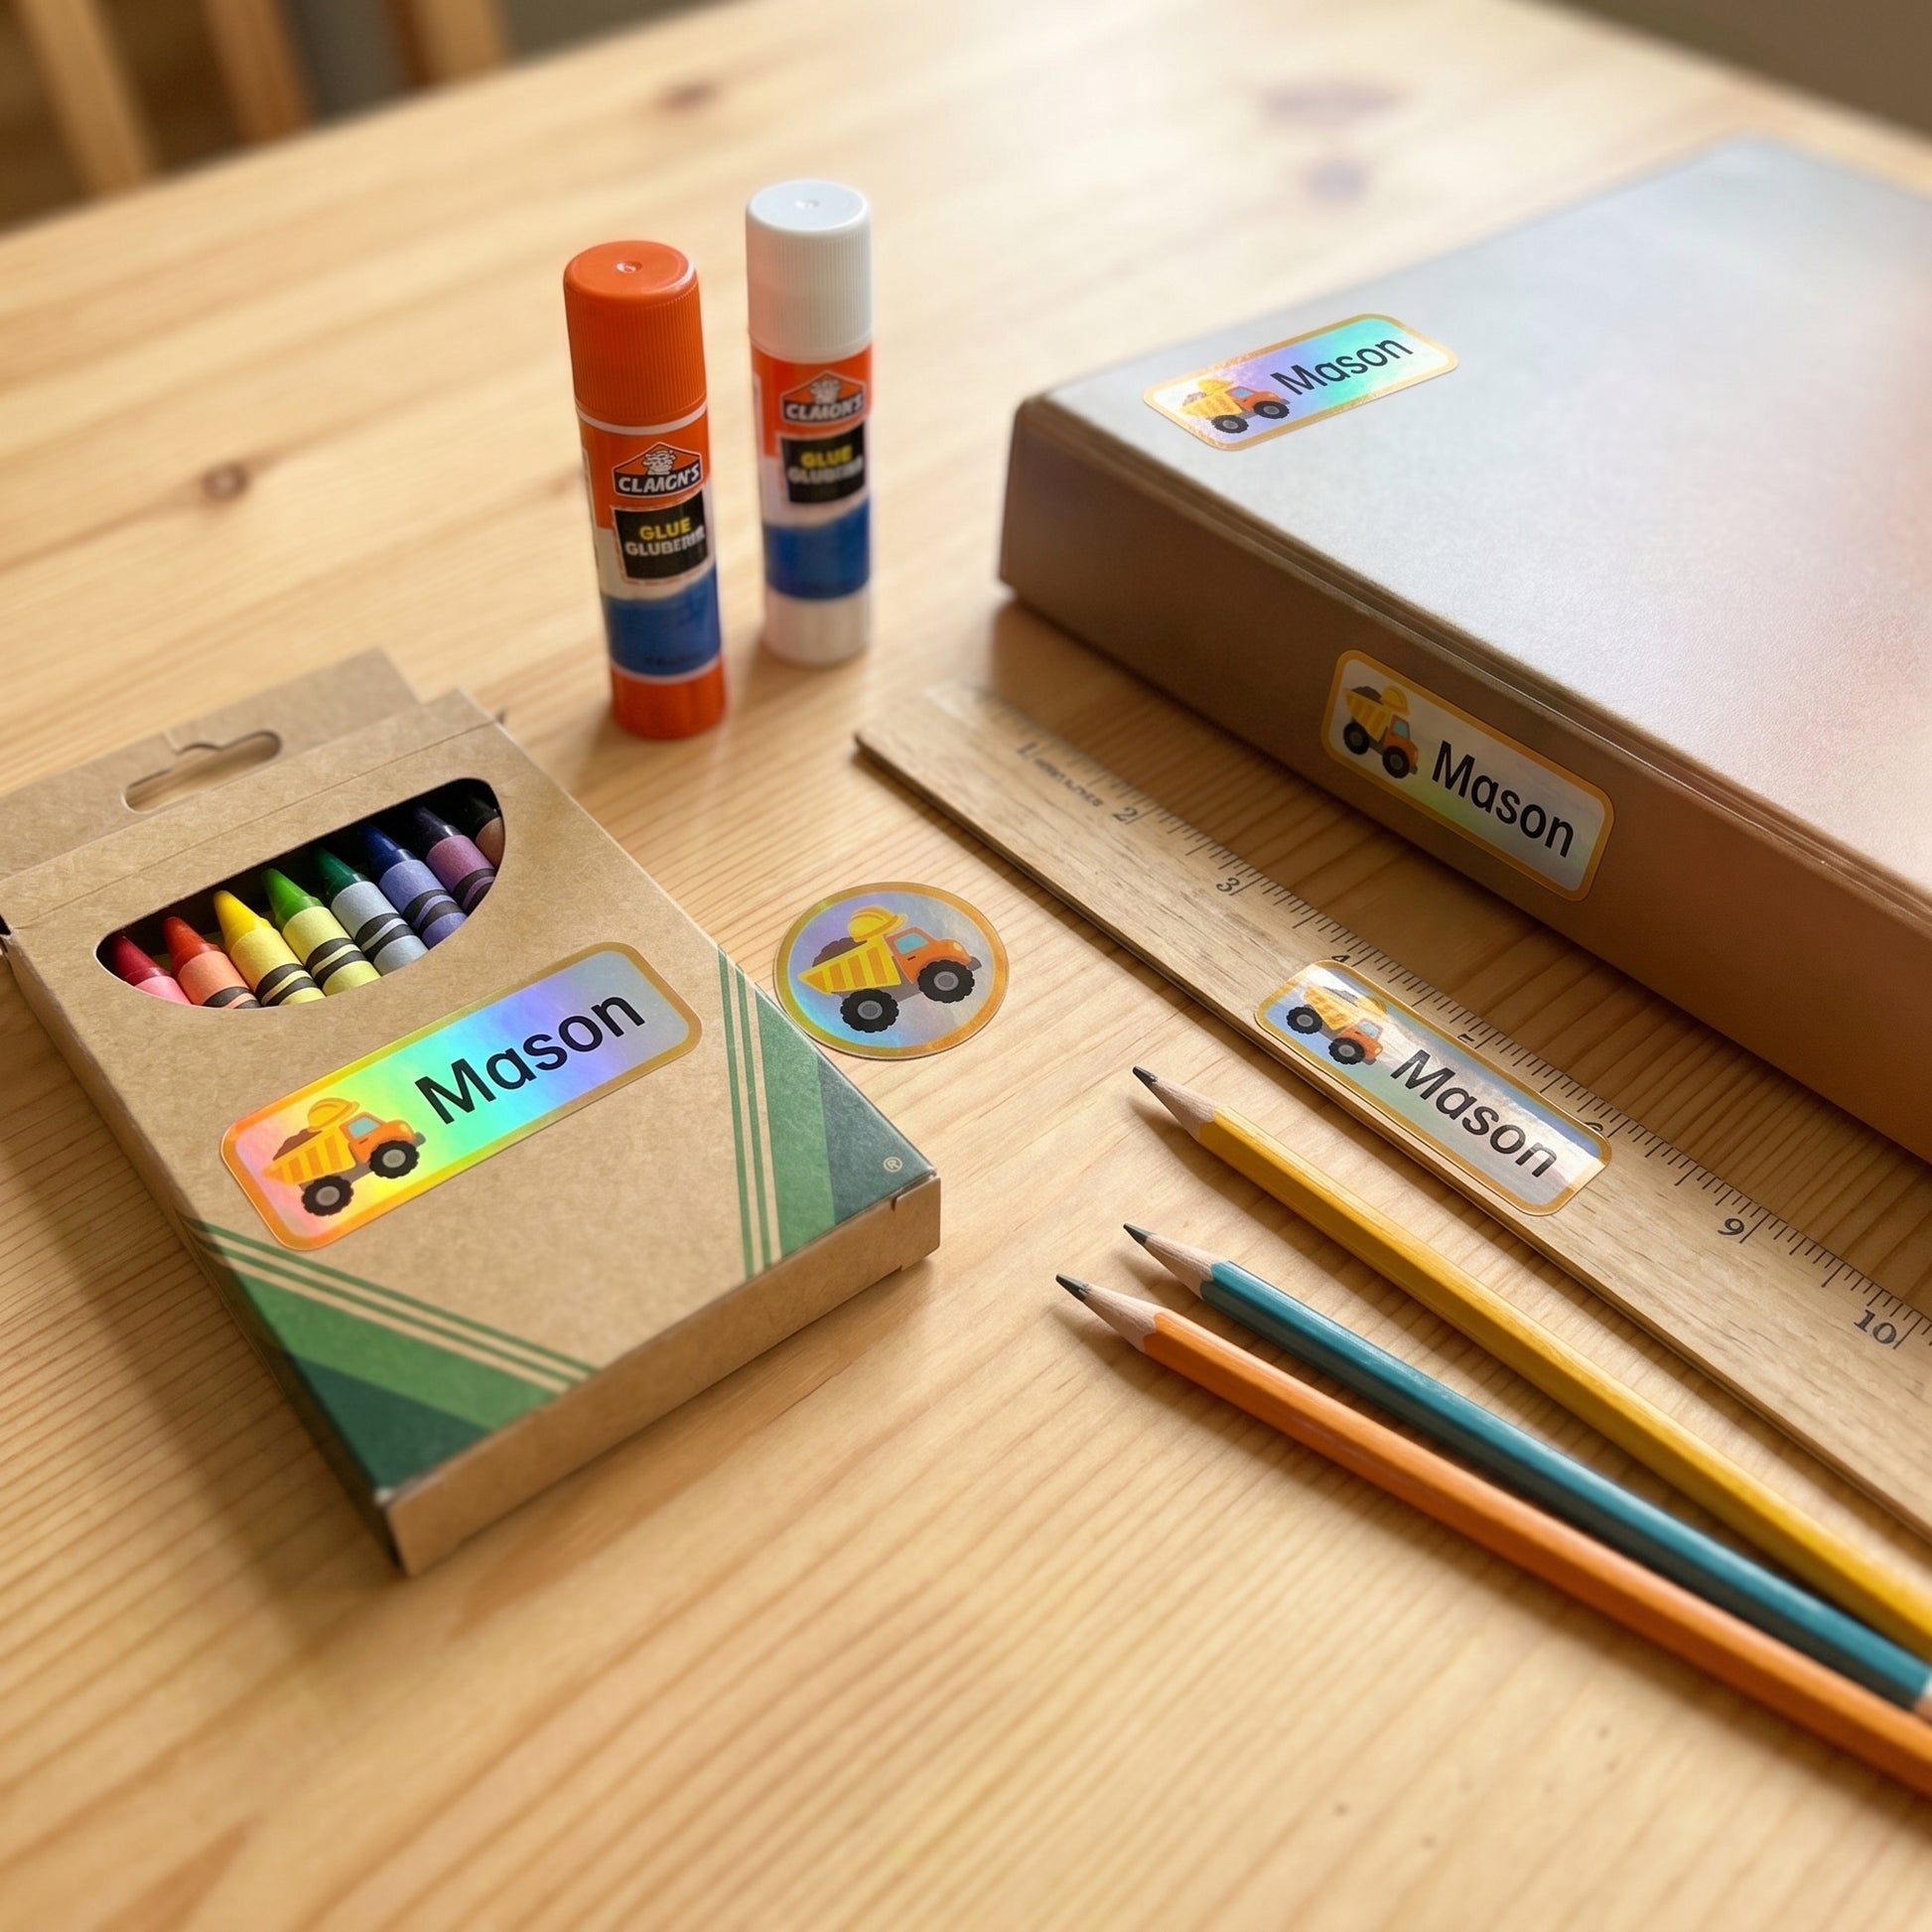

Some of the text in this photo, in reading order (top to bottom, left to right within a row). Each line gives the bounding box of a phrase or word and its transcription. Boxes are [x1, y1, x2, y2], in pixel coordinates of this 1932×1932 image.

[1270, 339, 1413, 395] Mason
[639, 517, 692, 540] GLUE
[1432, 740, 1575, 859] Mason
[414, 995, 645, 1125] Mason
[1112, 806, 1139, 822] 2
[1216, 877, 1240, 894] 3
[1717, 1217, 1745, 1236] 9
[1854, 1309, 1897, 1345] 10
[1390, 1048, 1558, 1178] Mason
